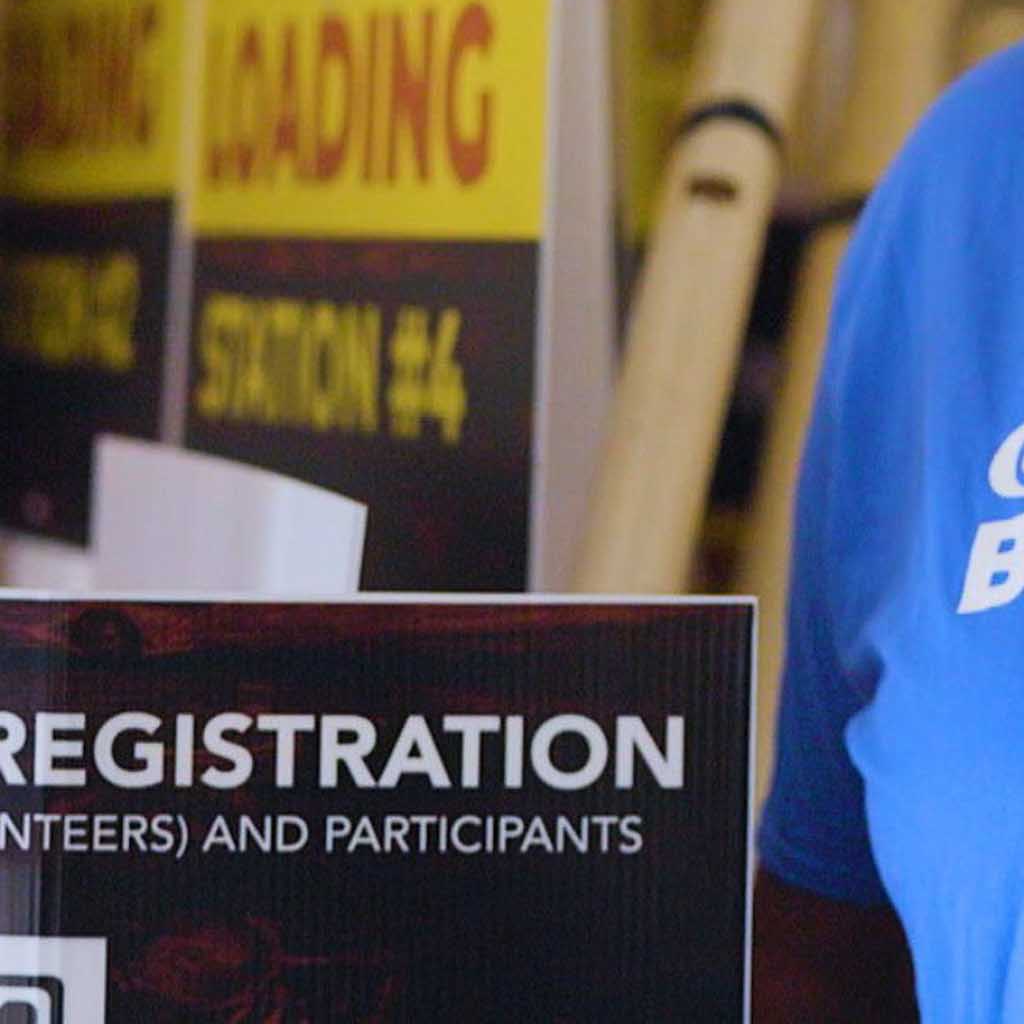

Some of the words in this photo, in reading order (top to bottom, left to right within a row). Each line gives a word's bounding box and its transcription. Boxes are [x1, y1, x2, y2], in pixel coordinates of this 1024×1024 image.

[206, 2, 494, 190] LOADING
[198, 290, 380, 433] STATION
[0, 812, 189, 859] NTEERS)
[202, 814, 309, 852] AND
[325, 814, 644, 854] PARTICIPANTS
